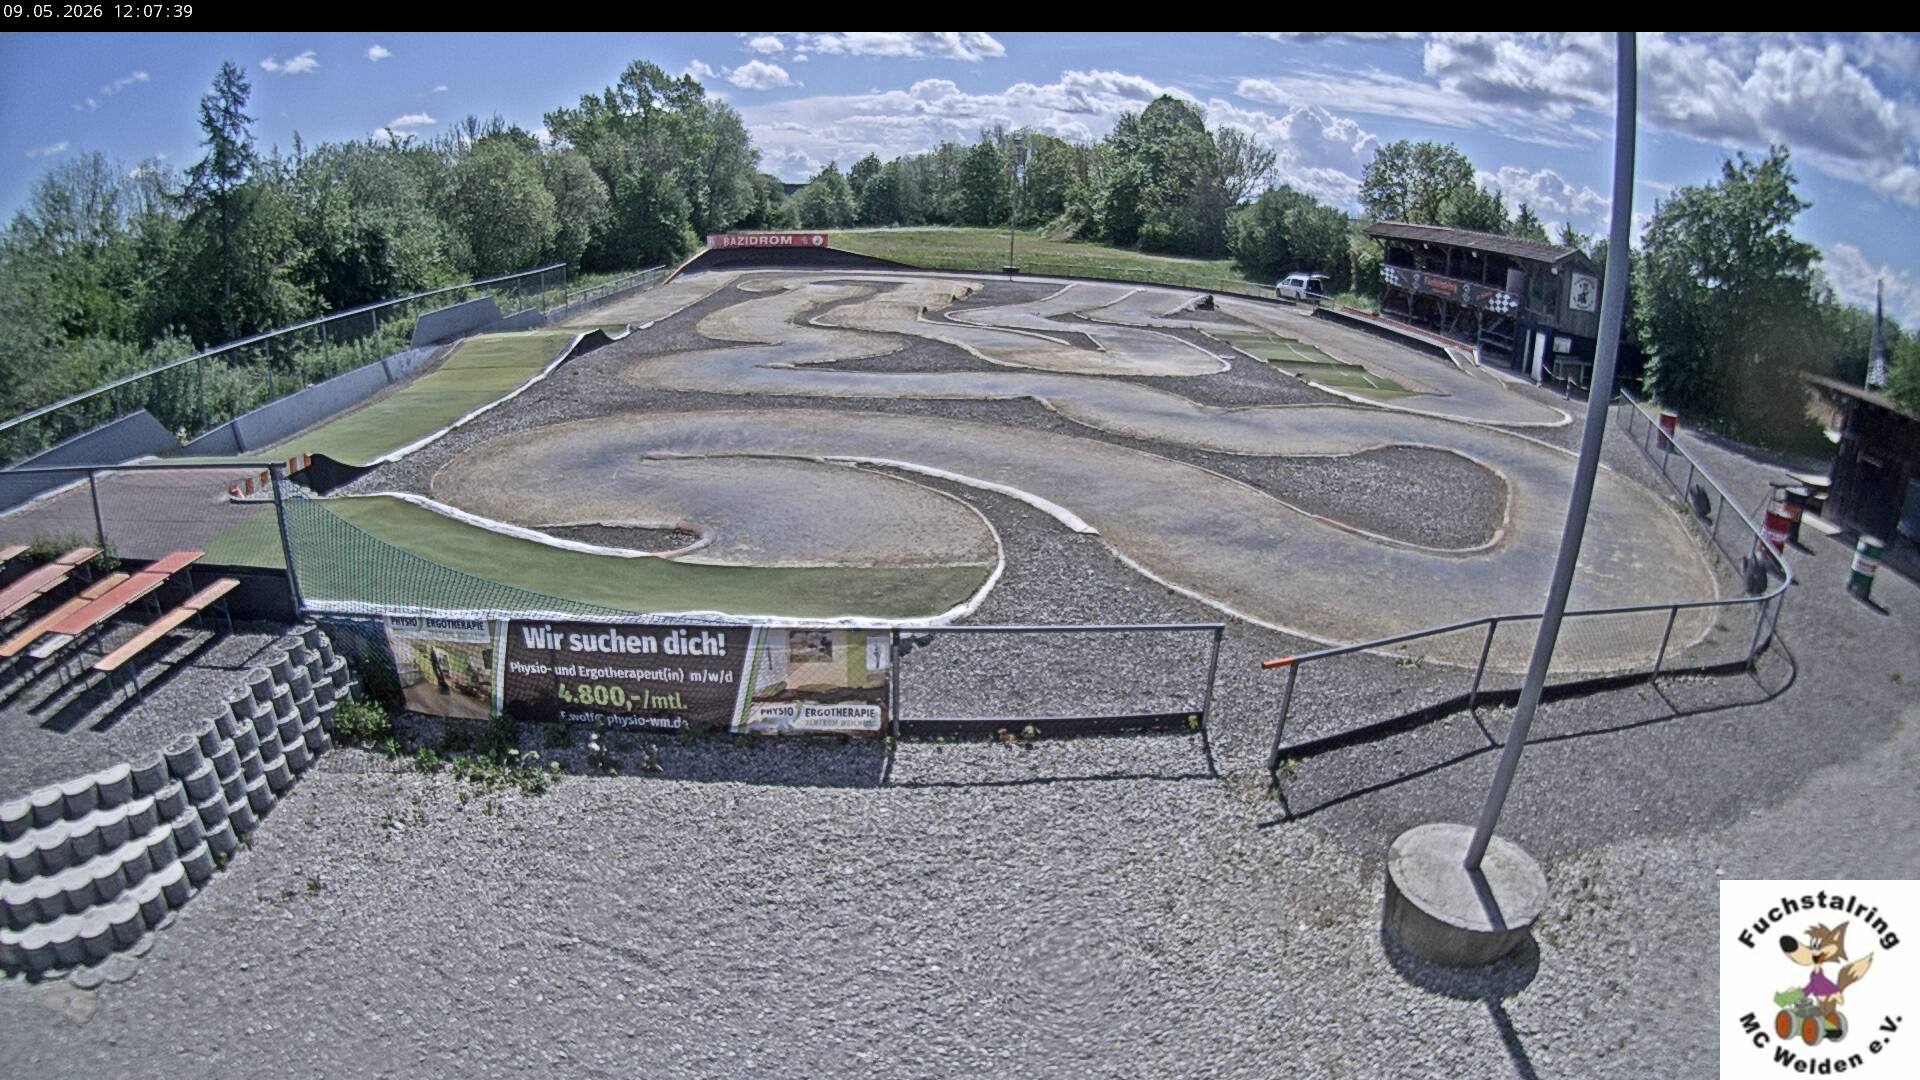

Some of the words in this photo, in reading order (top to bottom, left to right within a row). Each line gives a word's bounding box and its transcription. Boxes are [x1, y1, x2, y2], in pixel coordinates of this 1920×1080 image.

[723, 235, 793, 247] BAZIDROM
[390, 616, 418, 627] PHYSIO
[426, 618, 485, 631] ERGOTHERAPIE
[522, 624, 564, 650] Wir
[569, 628, 658, 654] suchen
[663, 629, 727, 657] dich!
[509, 661, 552, 676] Physio-
[554, 665, 577, 678] und
[578, 666, 684, 683] Ergotherapeut(in)
[690, 669, 734, 684] m/w/d
[760, 706, 795, 717] PHYSIO
[804, 707, 876, 718] ERGOTHERAPIE
